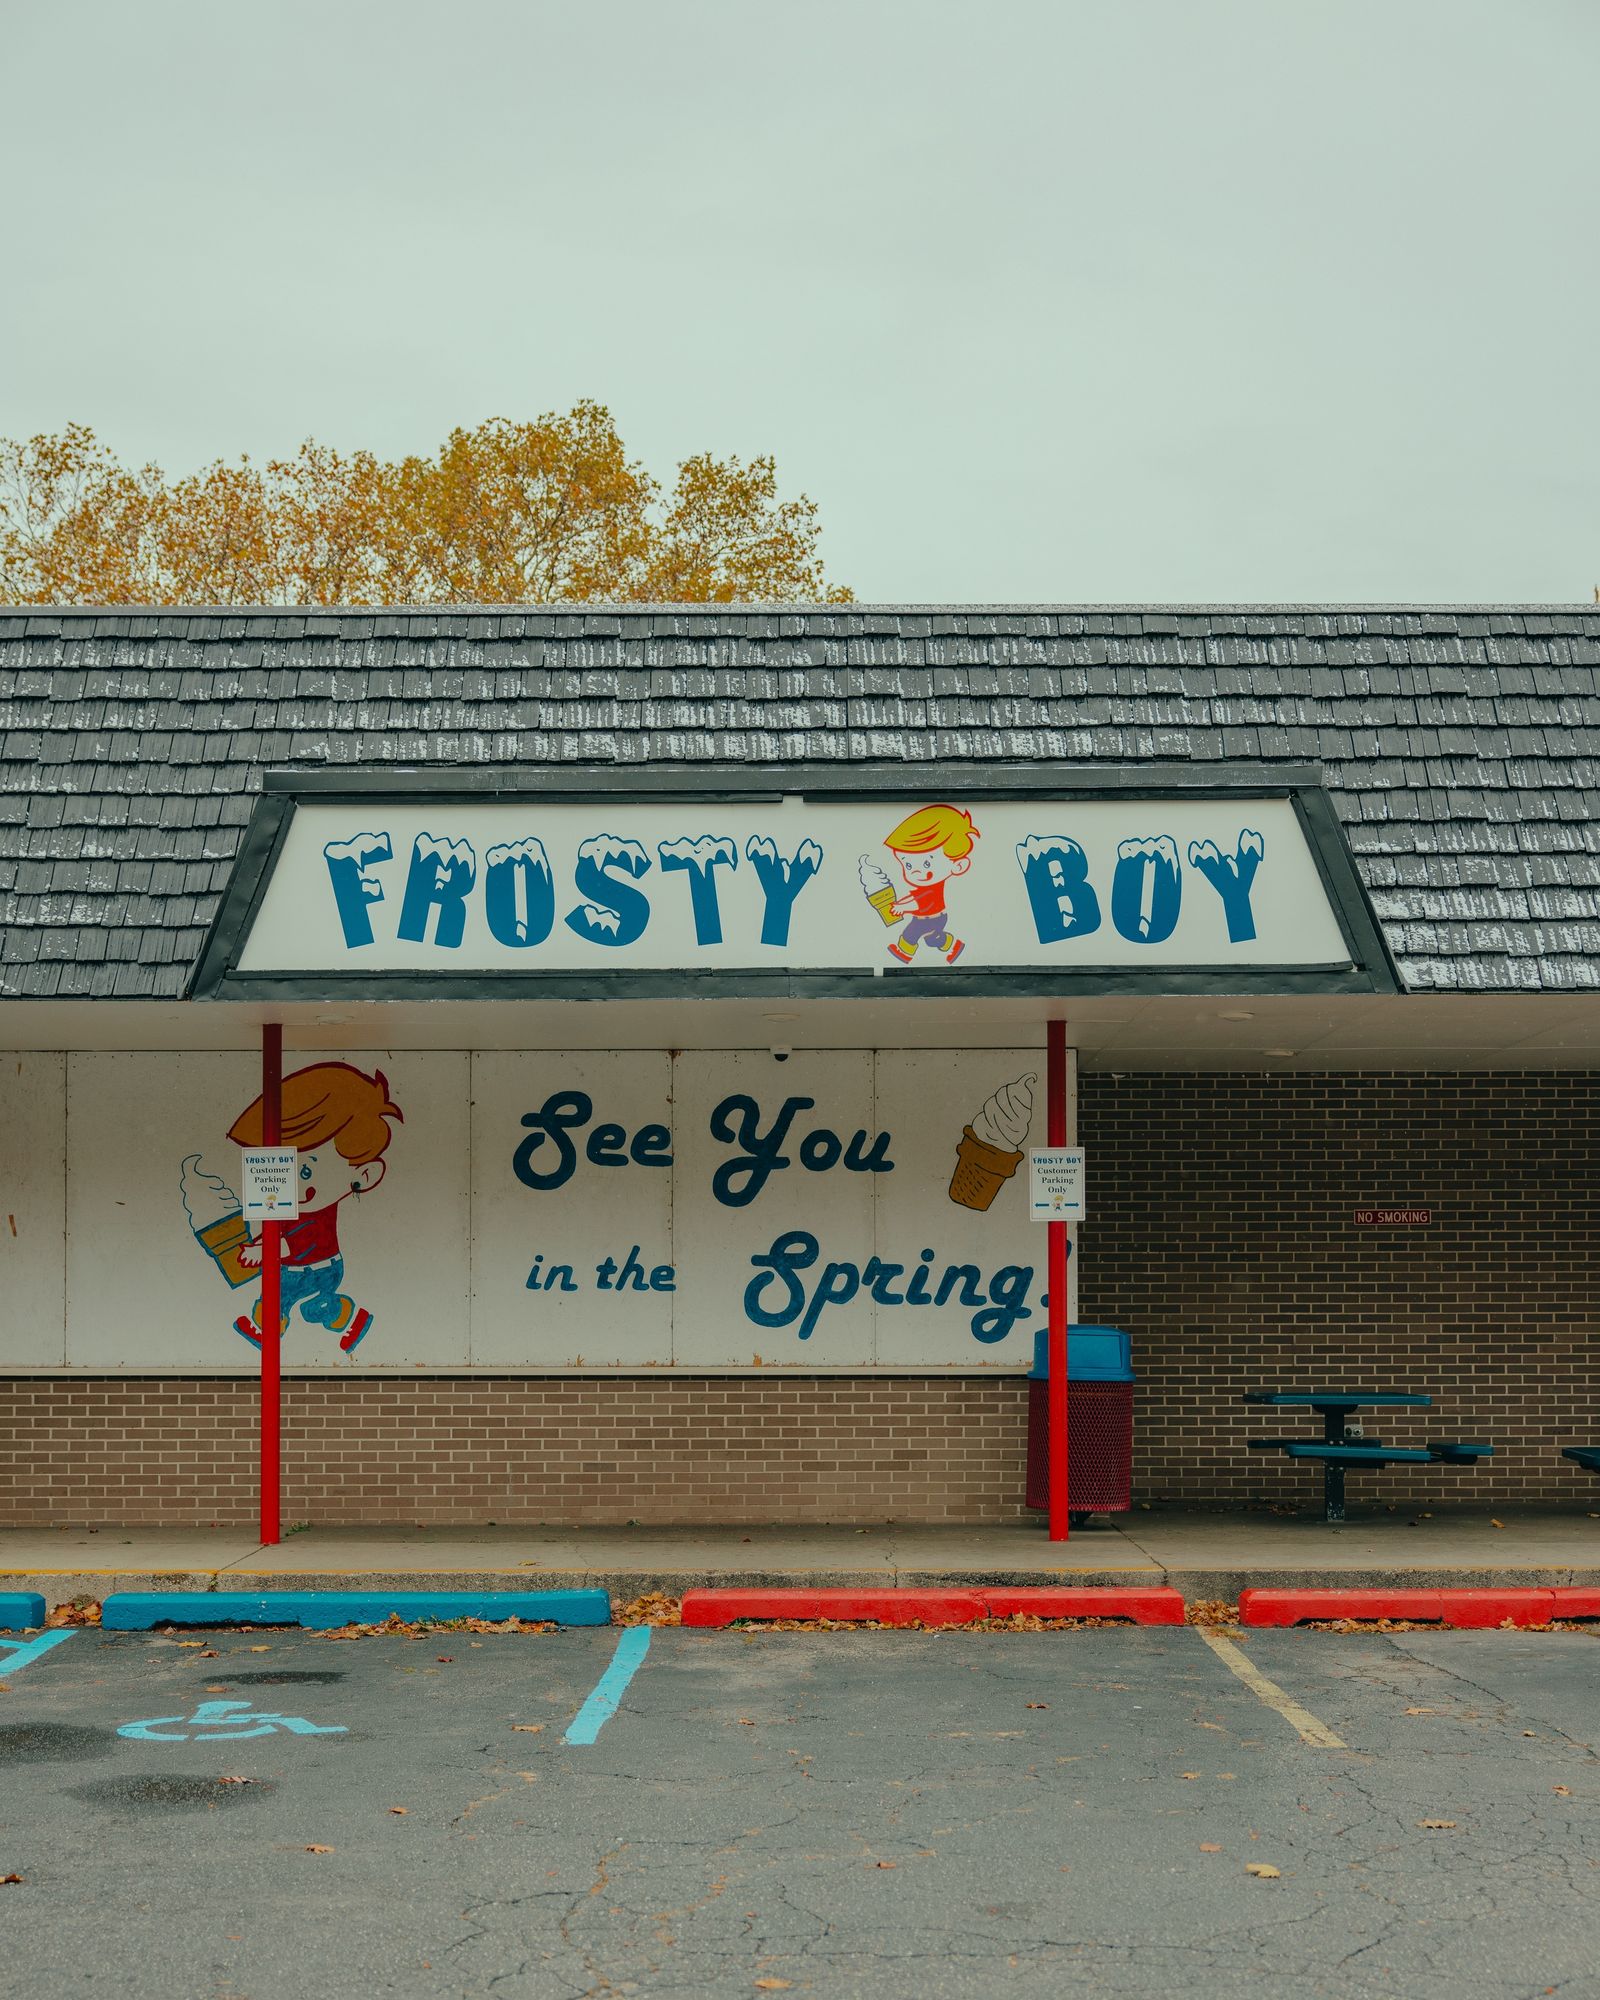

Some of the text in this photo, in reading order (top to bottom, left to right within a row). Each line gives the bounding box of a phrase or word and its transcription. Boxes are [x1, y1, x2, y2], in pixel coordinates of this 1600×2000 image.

[323, 828, 1264, 949] FROSTY BOY
[512, 1091, 895, 1207] See You
[245, 1156, 276, 1164] FROSTY
[254, 1176, 287, 1184] Parking
[1041, 1176, 1074, 1185] Parking
[261, 1185, 280, 1193] Only
[1048, 1186, 1067, 1194] Only
[1357, 1211, 1428, 1223] NO SMOKING
[525, 1254, 578, 1292] in
[596, 1245, 677, 1292] the
